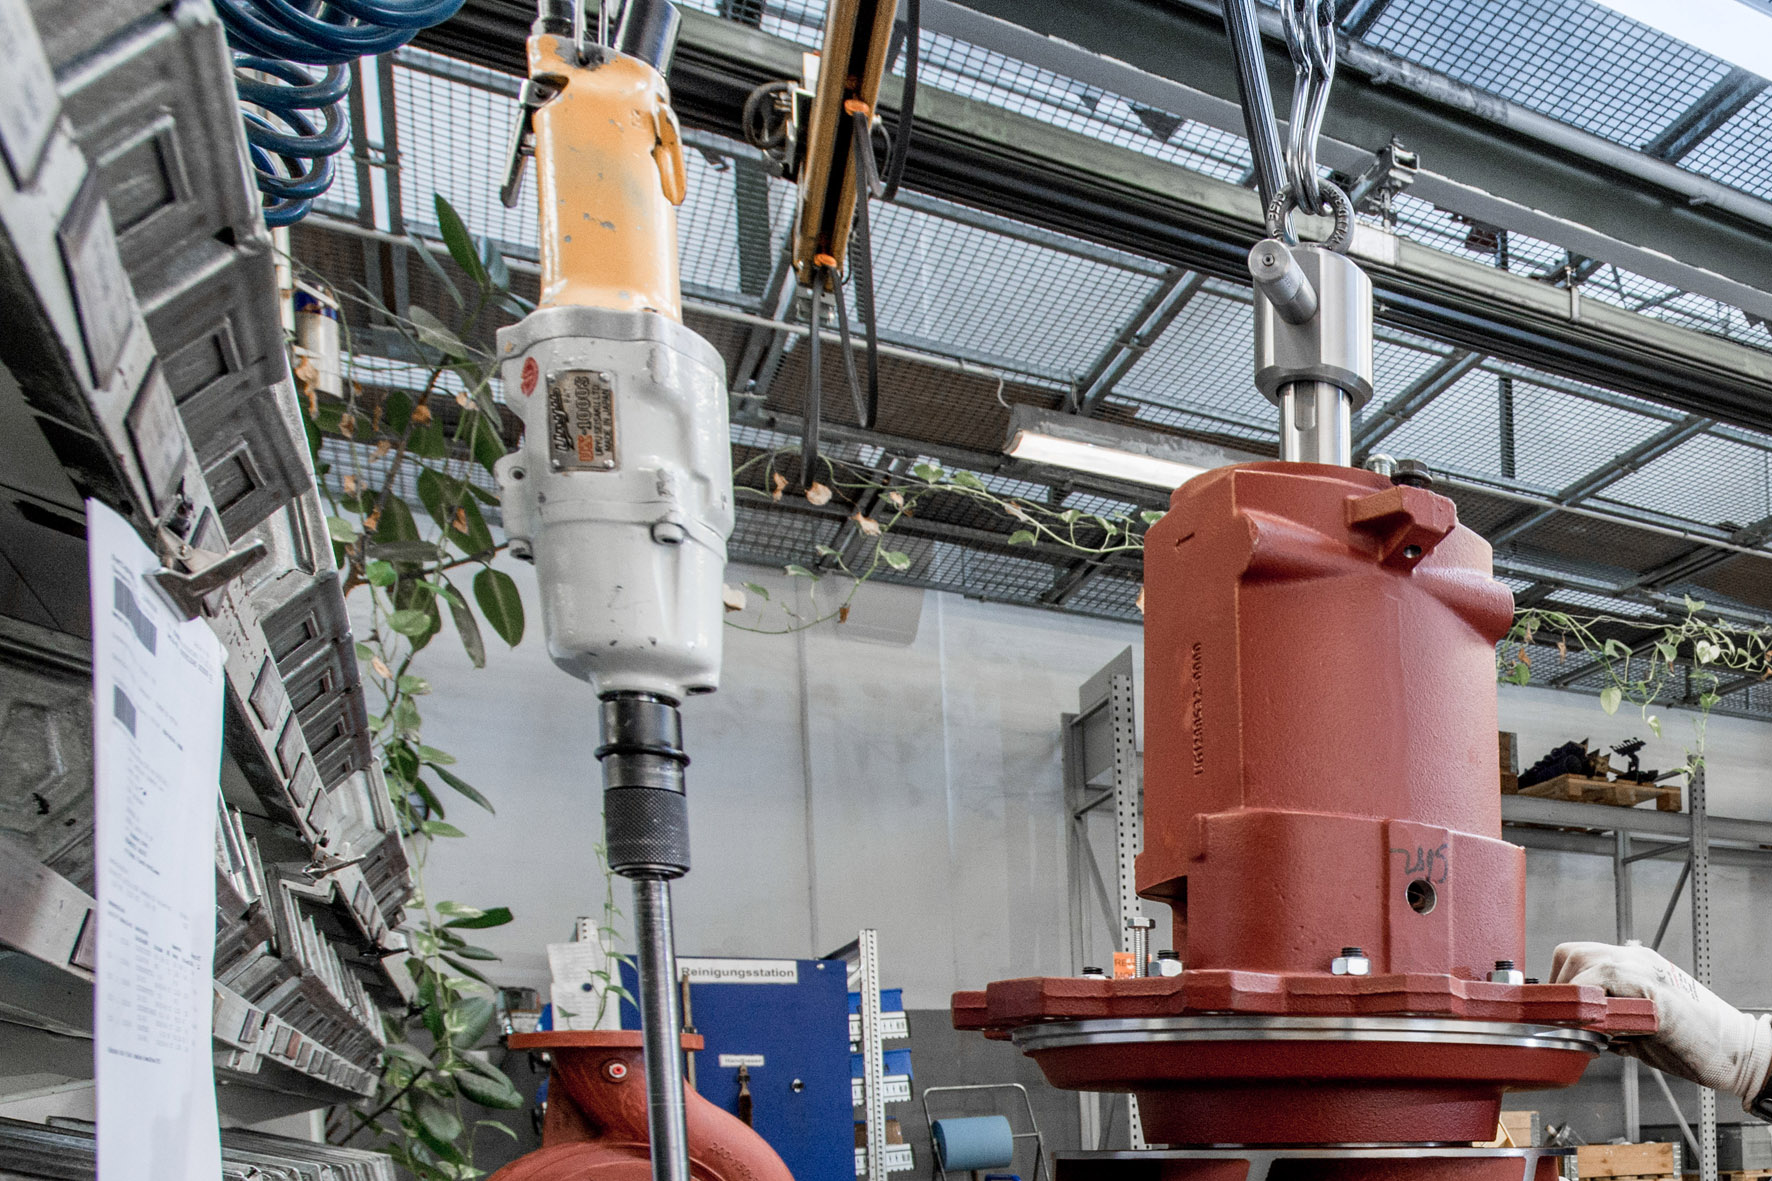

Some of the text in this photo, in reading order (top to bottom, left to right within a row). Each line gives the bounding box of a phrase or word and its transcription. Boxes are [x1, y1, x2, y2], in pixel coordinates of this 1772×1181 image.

[601, 388, 612, 452] MADE IN JAPAN
[680, 966, 795, 979] Reinigungsstation
